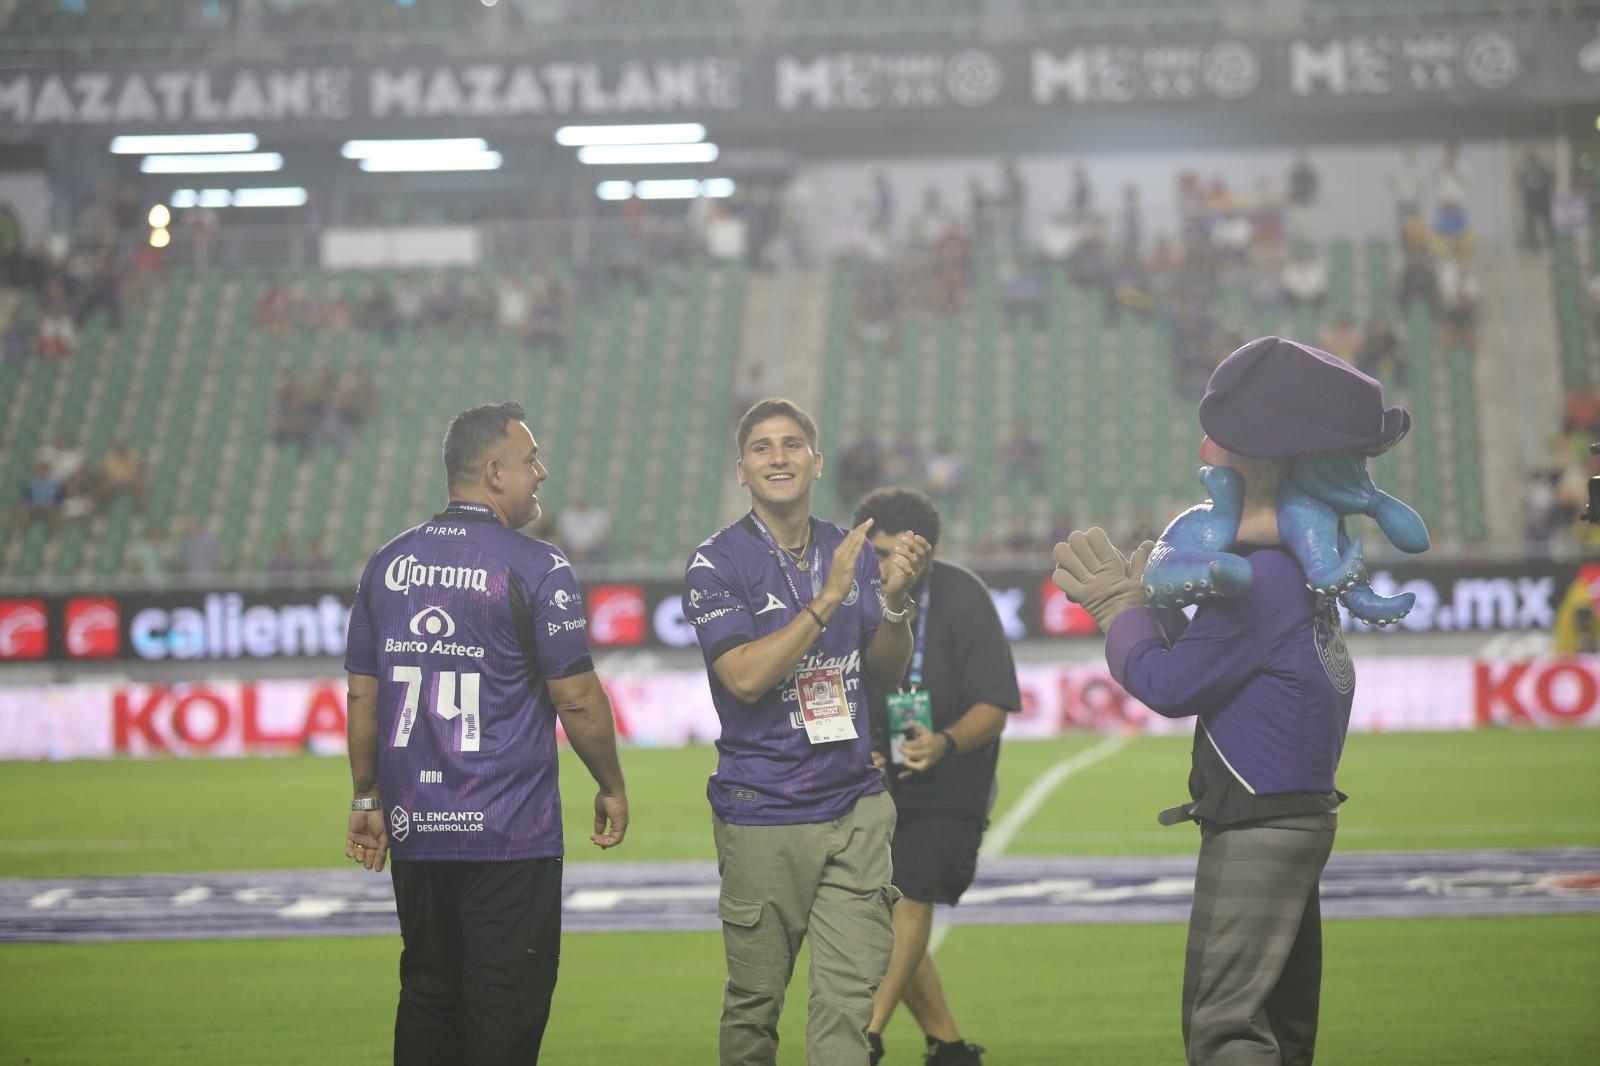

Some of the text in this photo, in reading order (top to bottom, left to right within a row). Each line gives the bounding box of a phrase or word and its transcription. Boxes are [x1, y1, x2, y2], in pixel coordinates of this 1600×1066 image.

[425, 526, 467, 536] PIRMA
[384, 554, 488, 595] Corona
[384, 638, 485, 658] Banco Azteca
[391, 665, 481, 752] 74
[402, 707, 412, 735] Orgullo
[465, 713, 475, 740] Orgullo
[413, 811, 484, 822] EL ENCANTO
[417, 822, 484, 832] DESARROLLOS
